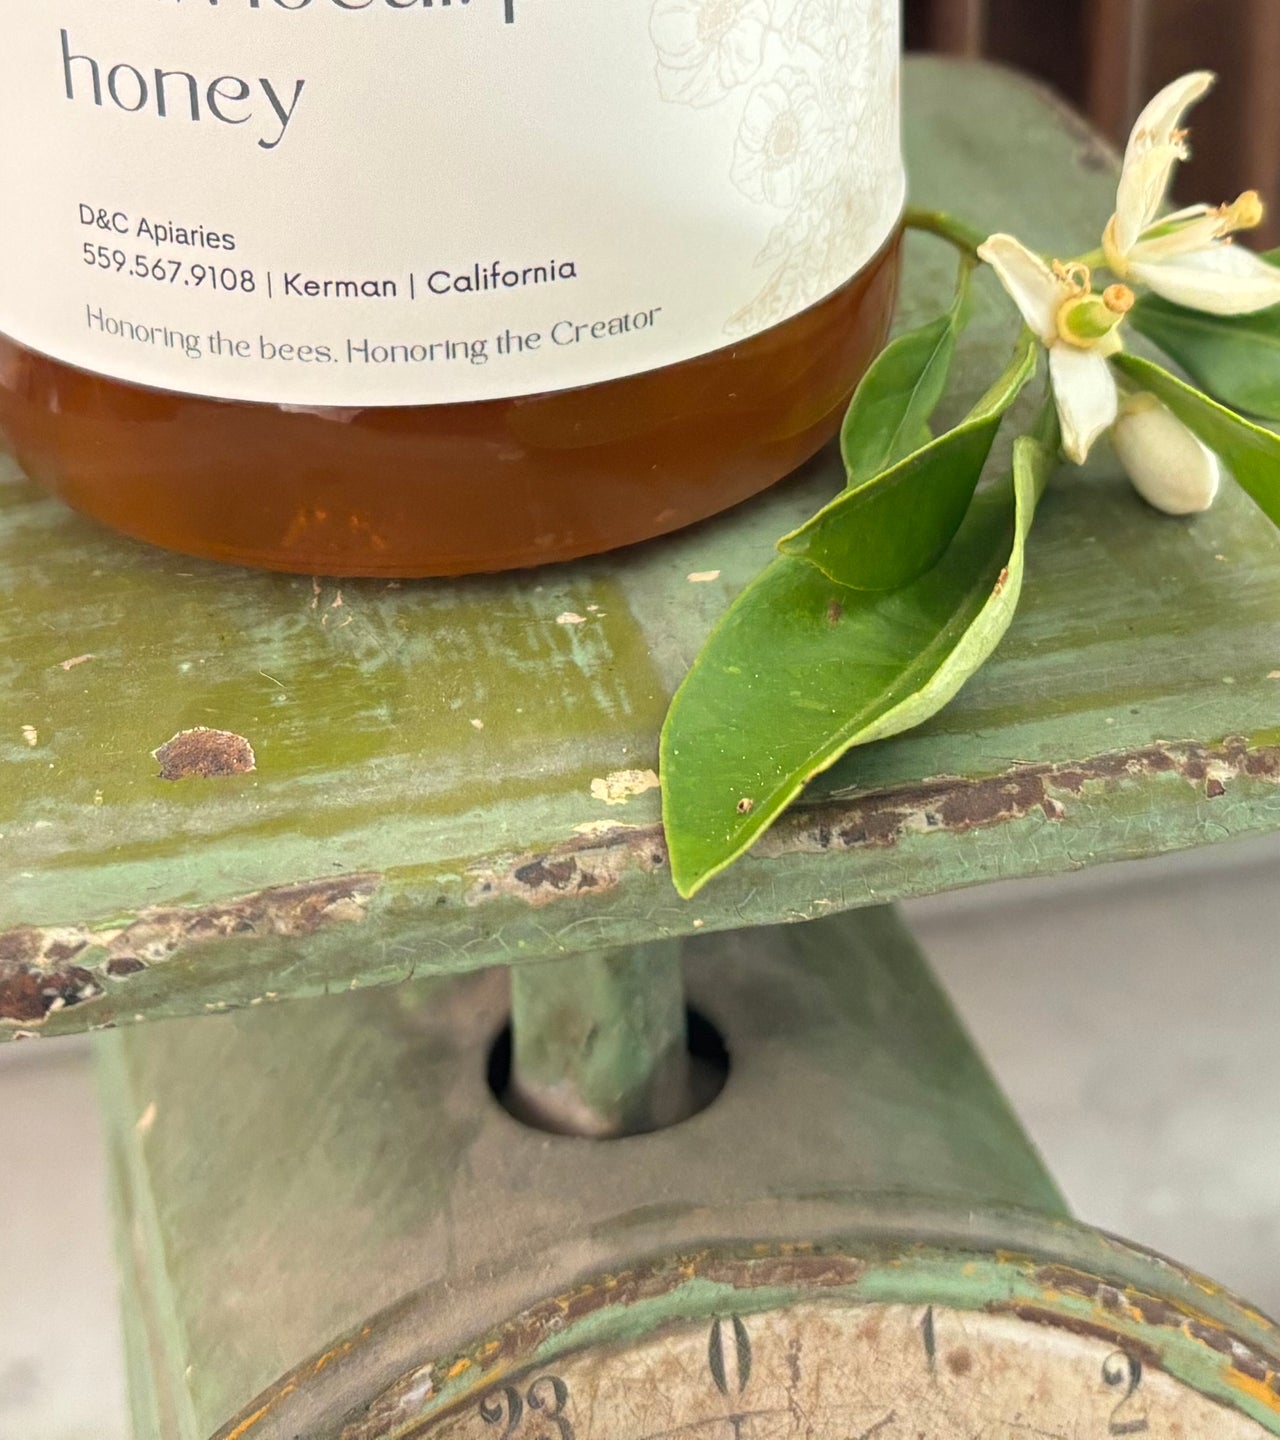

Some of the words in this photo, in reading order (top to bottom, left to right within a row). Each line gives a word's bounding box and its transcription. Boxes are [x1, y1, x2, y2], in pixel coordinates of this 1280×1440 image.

[60, 28, 305, 150] honey
[78, 203, 129, 234] D&C
[136, 216, 236, 251] Apiaries
[83, 242, 256, 293] 559.567.9108
[284, 272, 397, 298] Kerman
[427, 259, 577, 295] California
[86, 304, 202, 359] Honoring
[208, 330, 251, 358] the
[259, 335, 339, 364] bees.
[347, 338, 488, 365] Honoring
[496, 329, 541, 355] the
[551, 307, 662, 346] Creator
[708, 1313, 752, 1397] 0
[1101, 1349, 1149, 1435] 2
